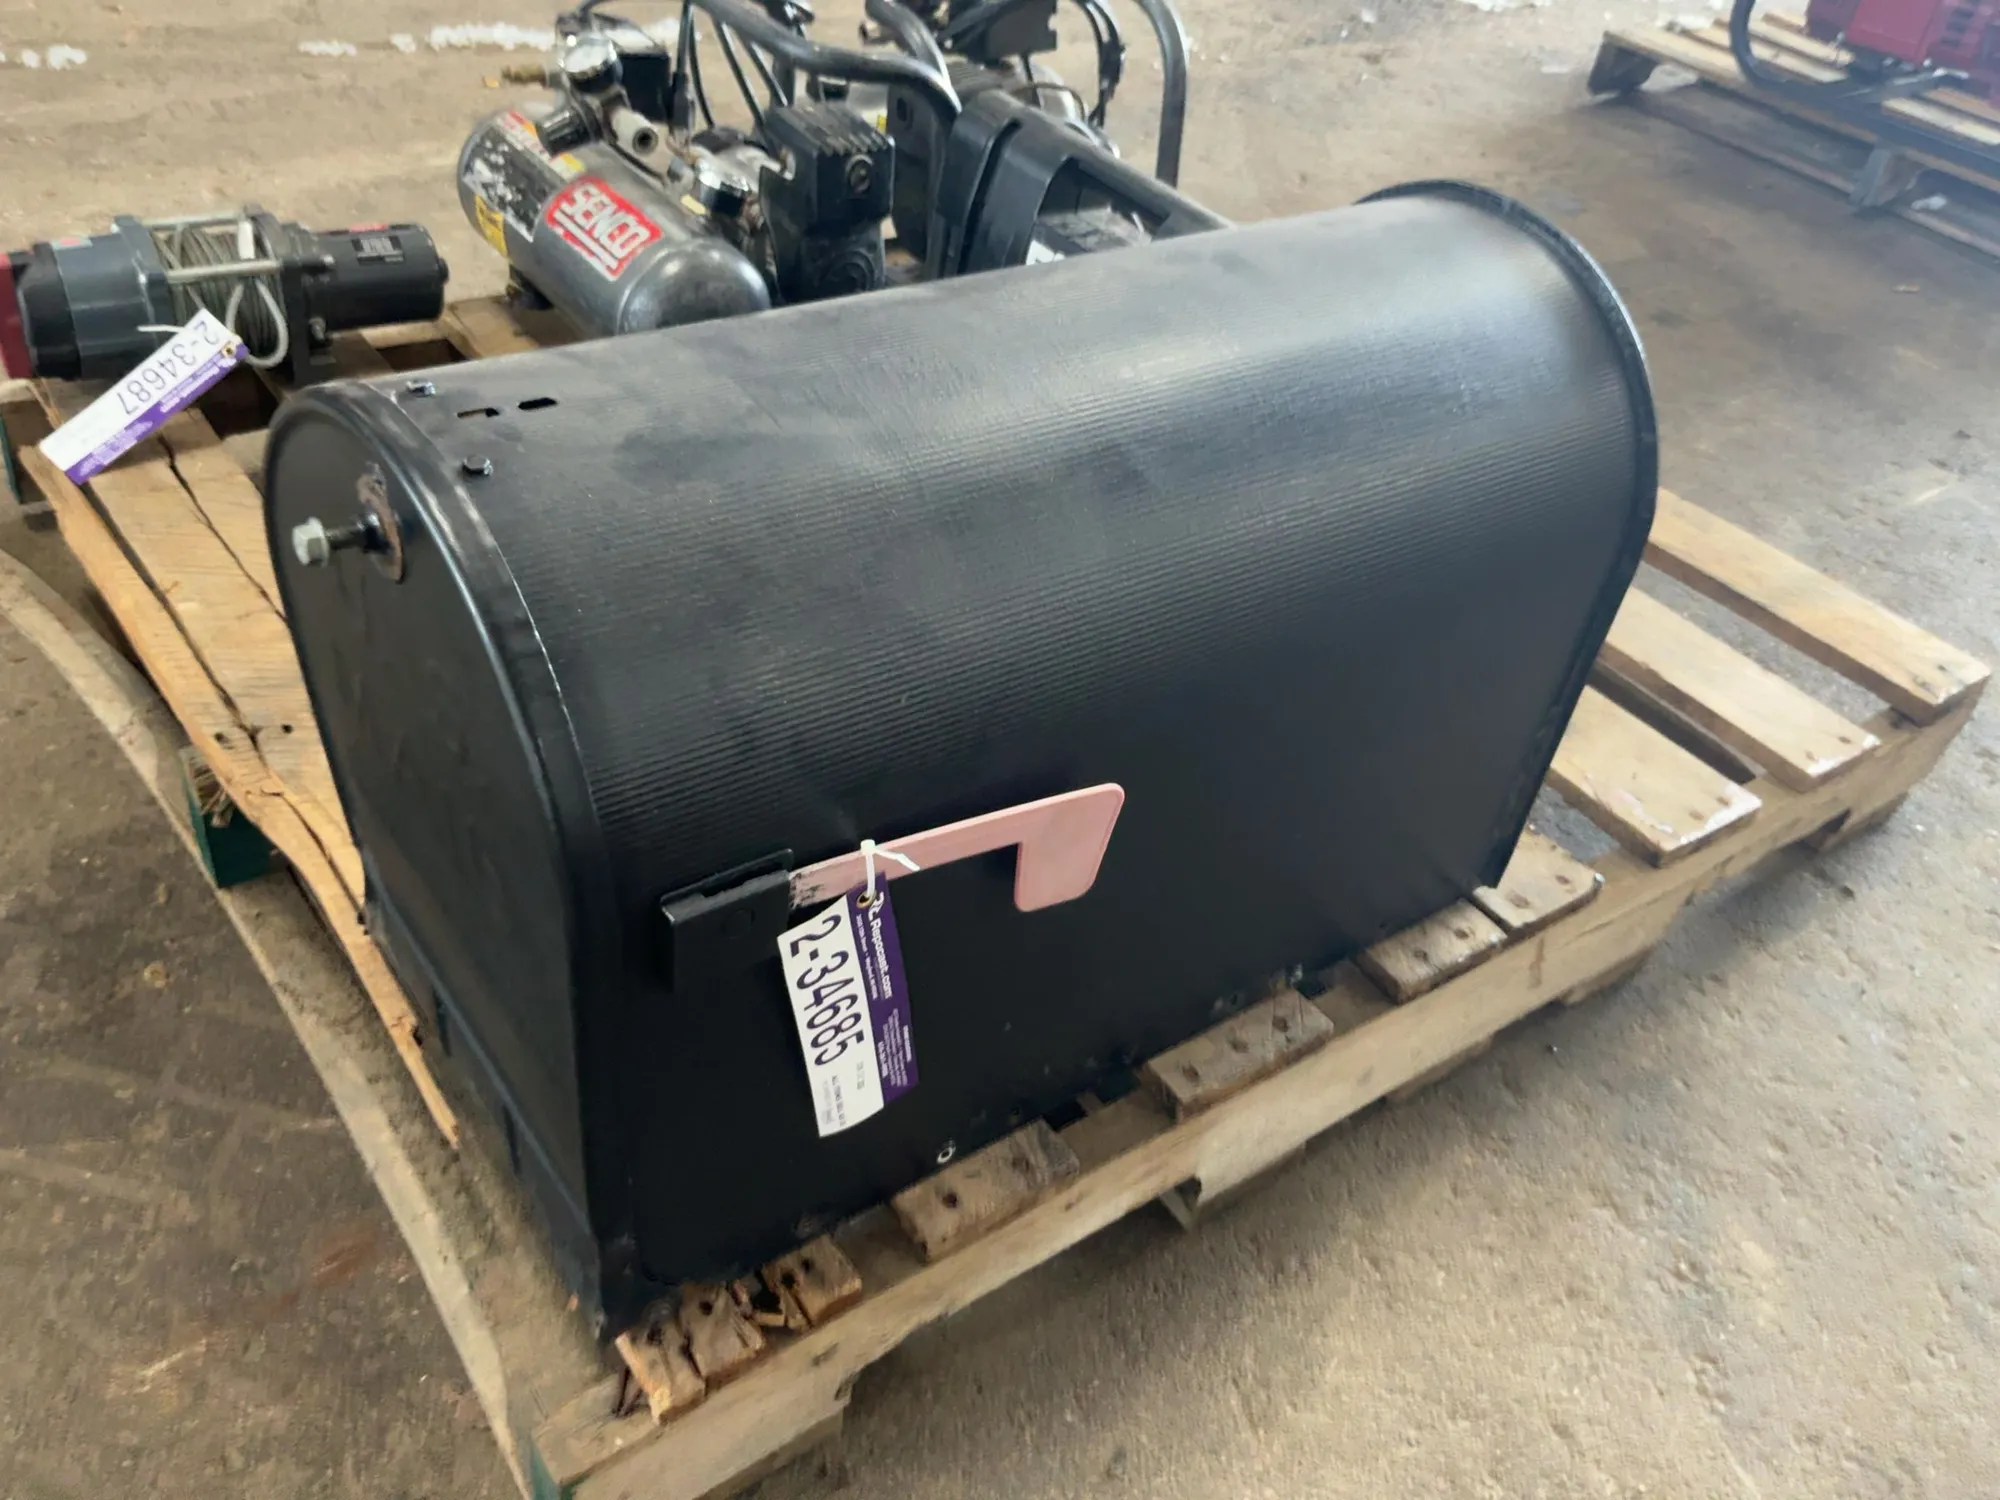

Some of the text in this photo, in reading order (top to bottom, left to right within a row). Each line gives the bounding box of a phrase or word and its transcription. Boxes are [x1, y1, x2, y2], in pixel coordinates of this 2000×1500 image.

[560, 182, 650, 260] SENCO
[116, 320, 221, 415] 2-34687
[789, 913, 865, 1067] 2-34685
[870, 917, 893, 999] Repocast.com
